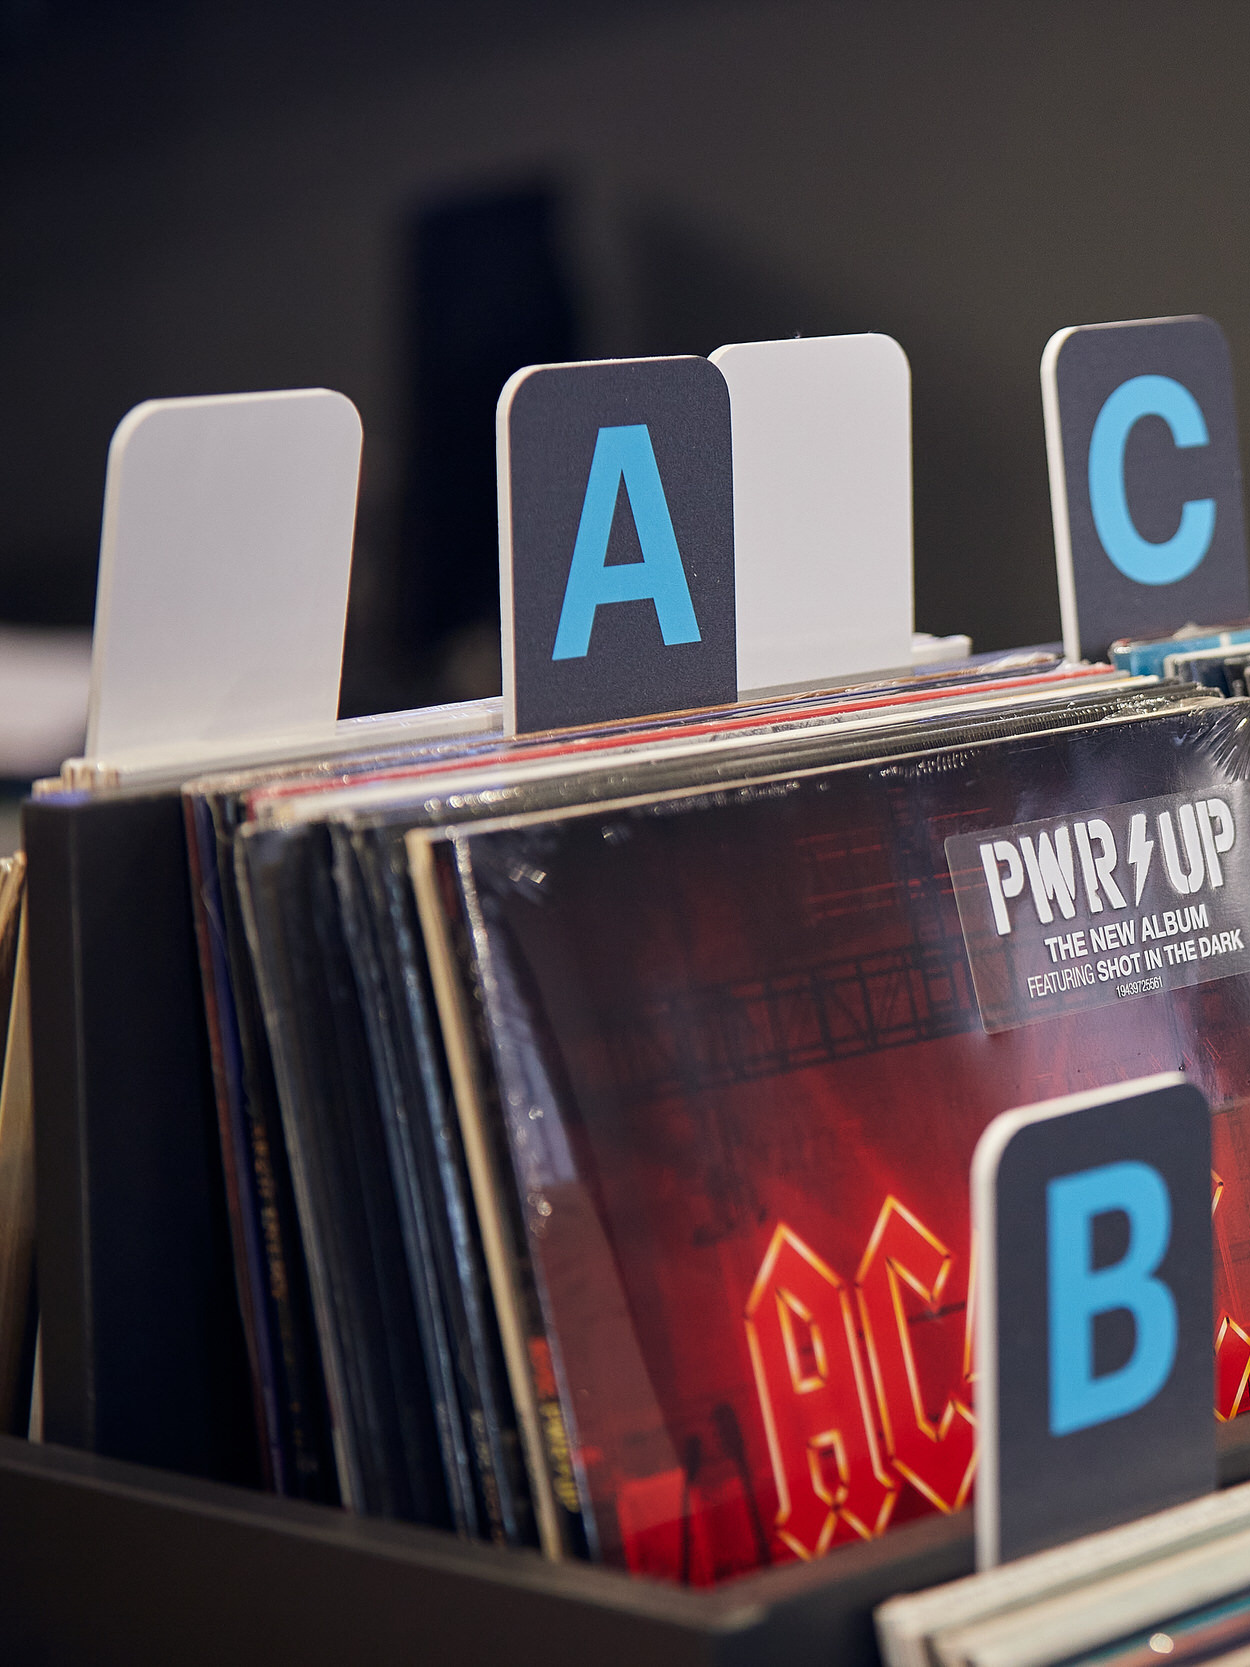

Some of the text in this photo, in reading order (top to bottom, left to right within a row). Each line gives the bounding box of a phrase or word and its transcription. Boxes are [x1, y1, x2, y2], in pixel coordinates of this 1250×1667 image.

[551, 423, 702, 662] A
[1087, 373, 1216, 585] C
[1027, 929, 1245, 998] FEATURING SHOT IN THE DARK
[1044, 904, 1209, 962] THE NEW ALBUM
[1115, 975, 1163, 998] 19439725561
[1045, 1160, 1179, 1437] B
